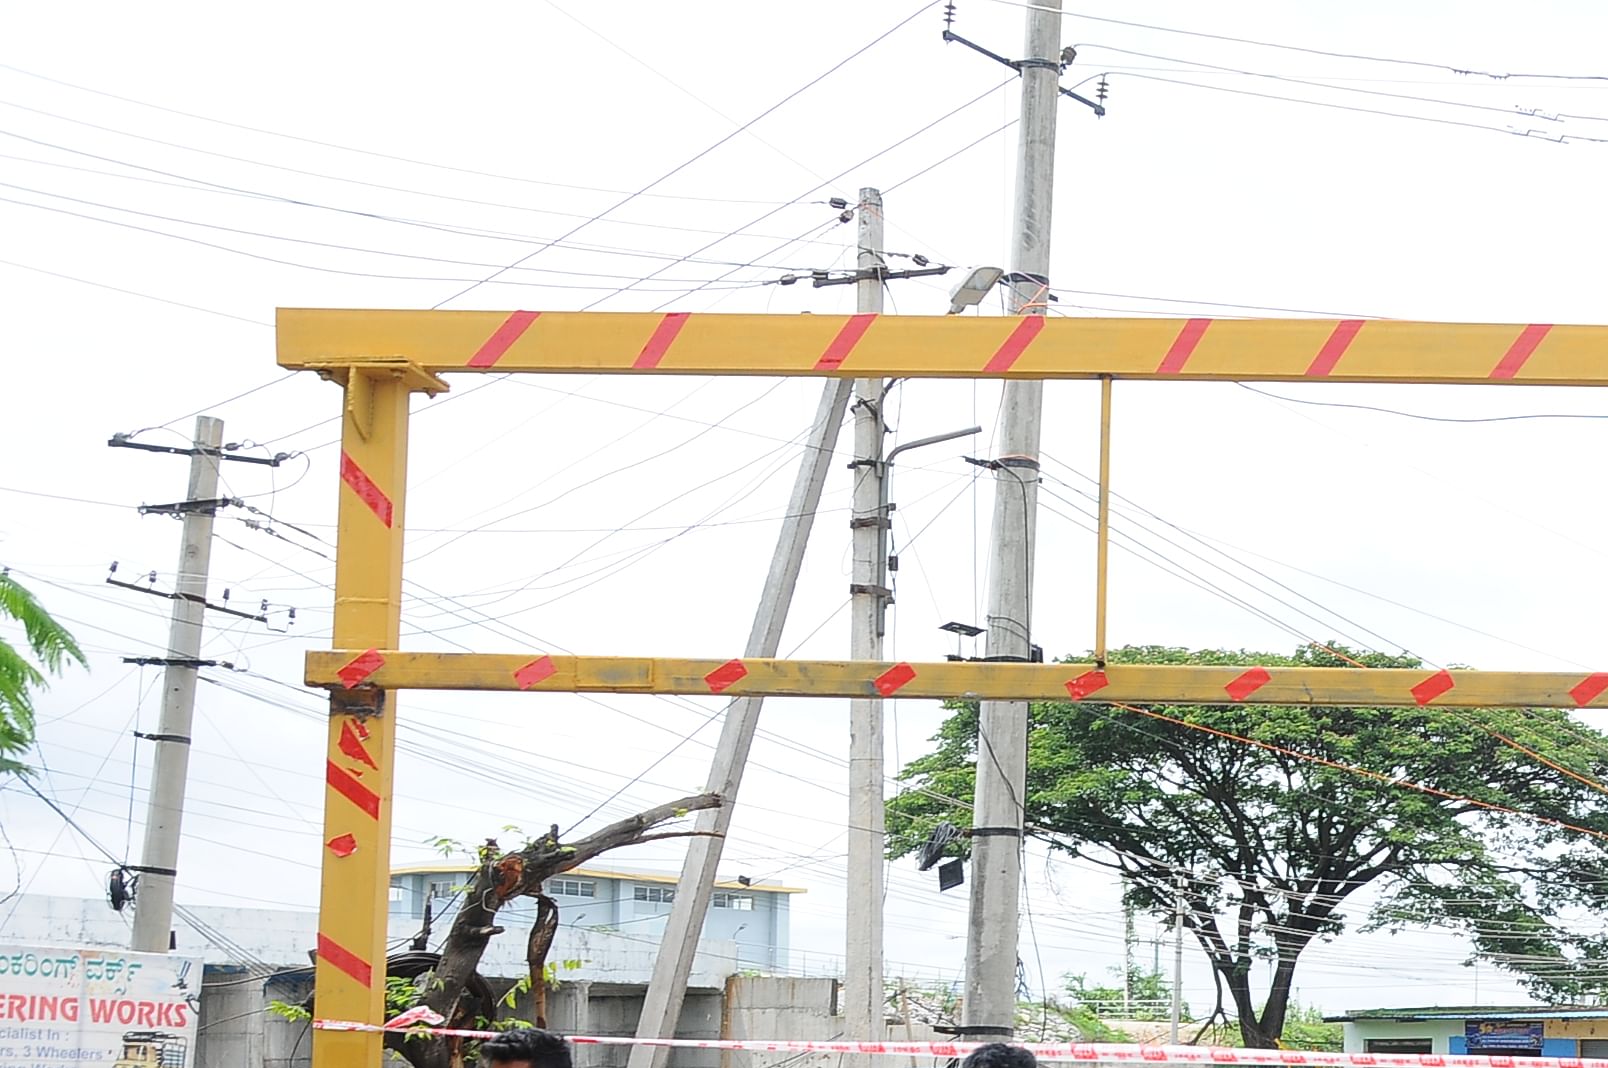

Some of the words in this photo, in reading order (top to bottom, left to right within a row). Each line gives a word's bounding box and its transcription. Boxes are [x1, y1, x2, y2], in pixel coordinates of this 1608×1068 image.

[89, 998, 187, 1028] WORKS
[48, 1029, 60, 1040] In
[23, 1046, 32, 1058] 3
[36, 1046, 103, 1060] Wheelers
